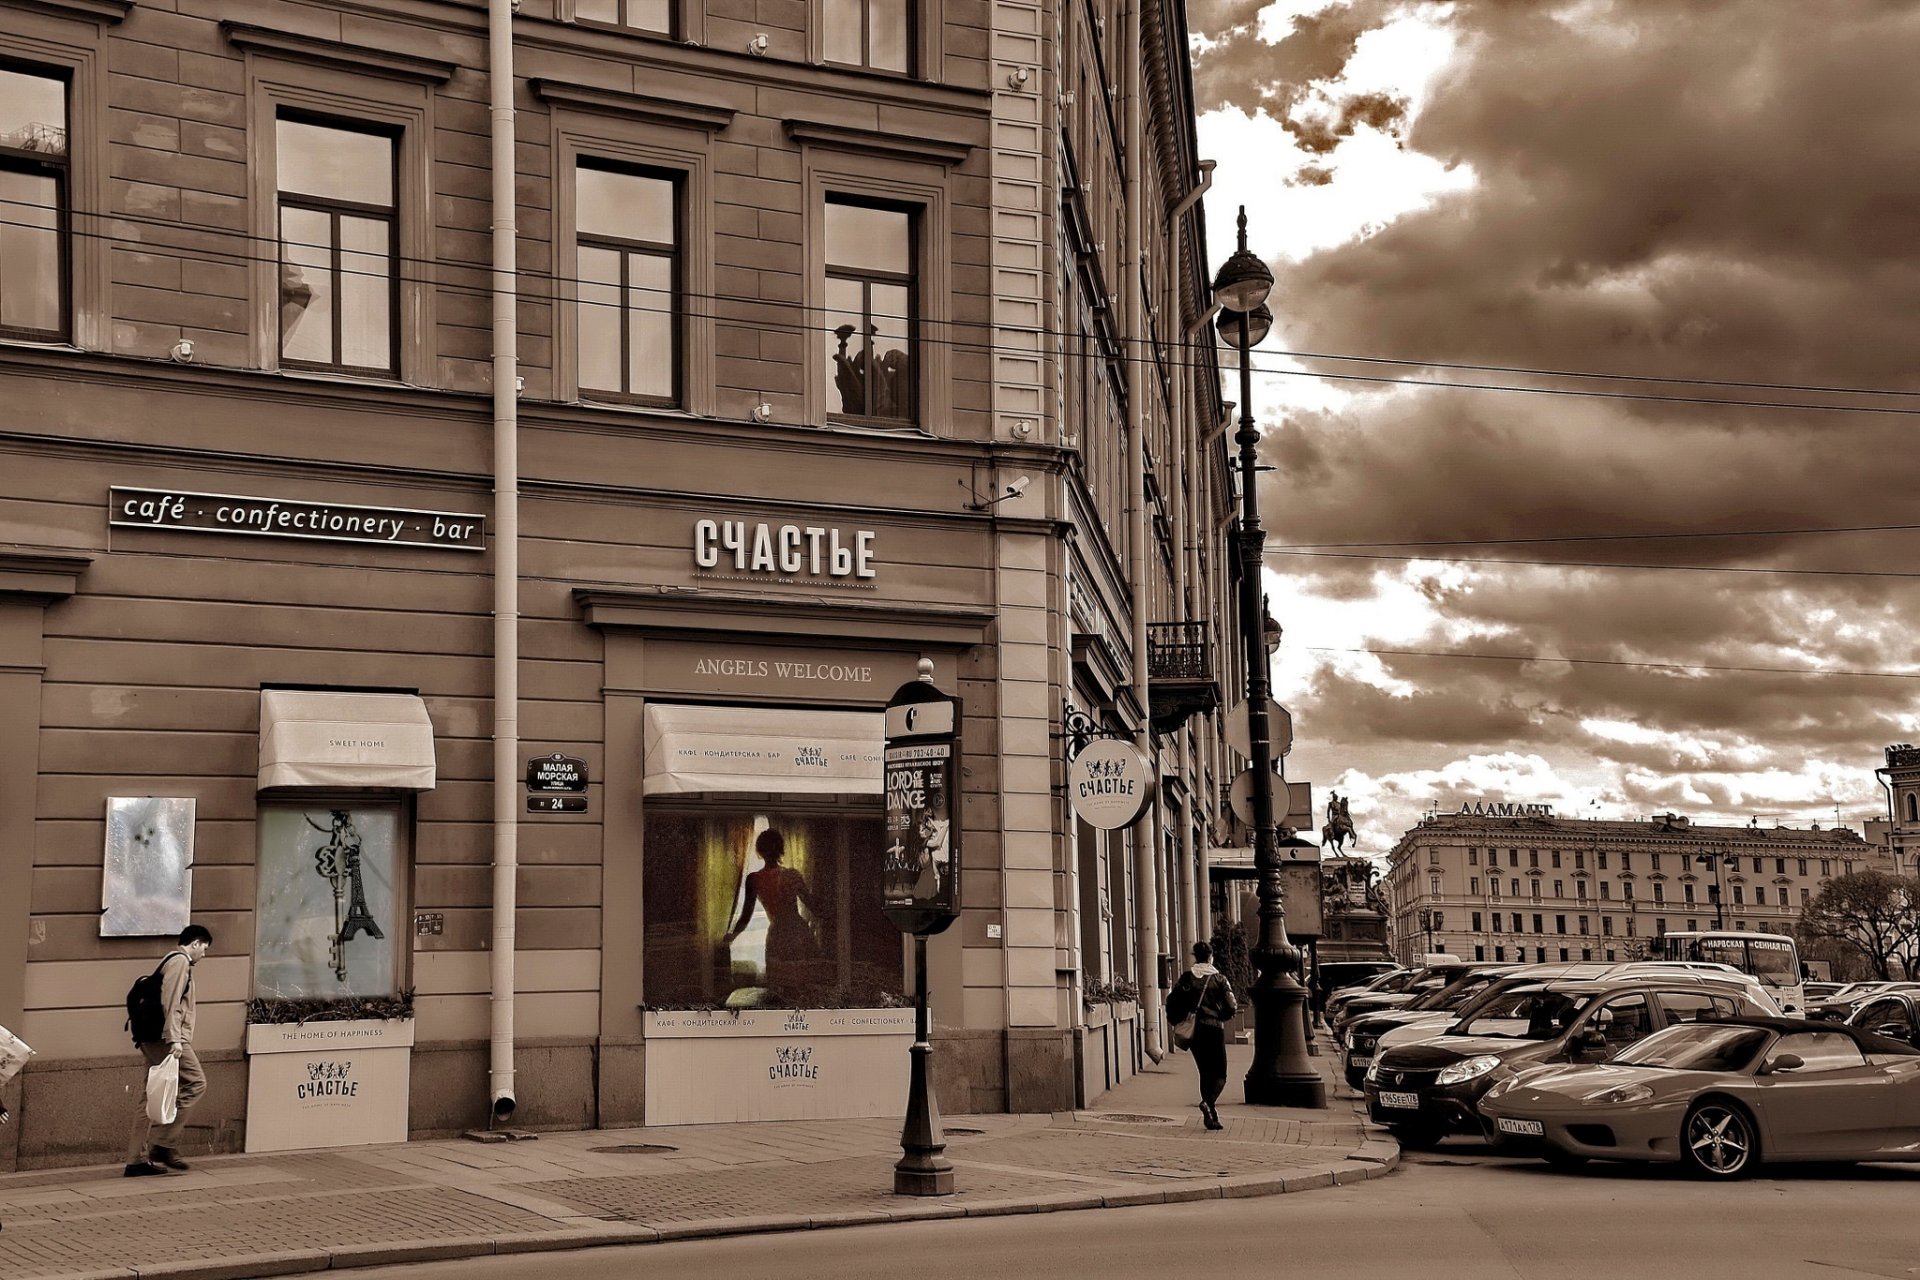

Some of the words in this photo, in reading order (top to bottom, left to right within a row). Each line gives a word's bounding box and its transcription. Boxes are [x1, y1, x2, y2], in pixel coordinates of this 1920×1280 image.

[123, 496, 185, 523] café
[216, 504, 404, 540] confectionery
[432, 517, 474, 539] bar
[694, 519, 876, 578] СЧАСТЬЕ
[694, 659, 769, 677] ANGELS
[774, 662, 872, 682] WELCOME
[360, 740, 385, 748] HOME
[543, 763, 573, 772] МАЛАЯ
[794, 756, 828, 767] СЧАСТЬЕ
[537, 771, 579, 781] МОРСКАЯ
[887, 770, 913, 792] LORD
[1079, 778, 1135, 798] СЧАСТЬЕ
[551, 798, 563, 809] 24
[887, 790, 926, 810] DANCE
[1707, 939, 1745, 949] НАРВСКАЯ
[1754, 940, 1782, 951] СЕННАЯ
[784, 1022, 810, 1031] СЧАСТЬЕ
[282, 1032, 297, 1040] THE
[300, 1031, 324, 1039] HOME
[340, 1029, 383, 1038] HAPPINESS
[769, 1064, 819, 1080] СЧАСТЬЕ
[297, 1080, 359, 1099] СЧАСТЬЕ
